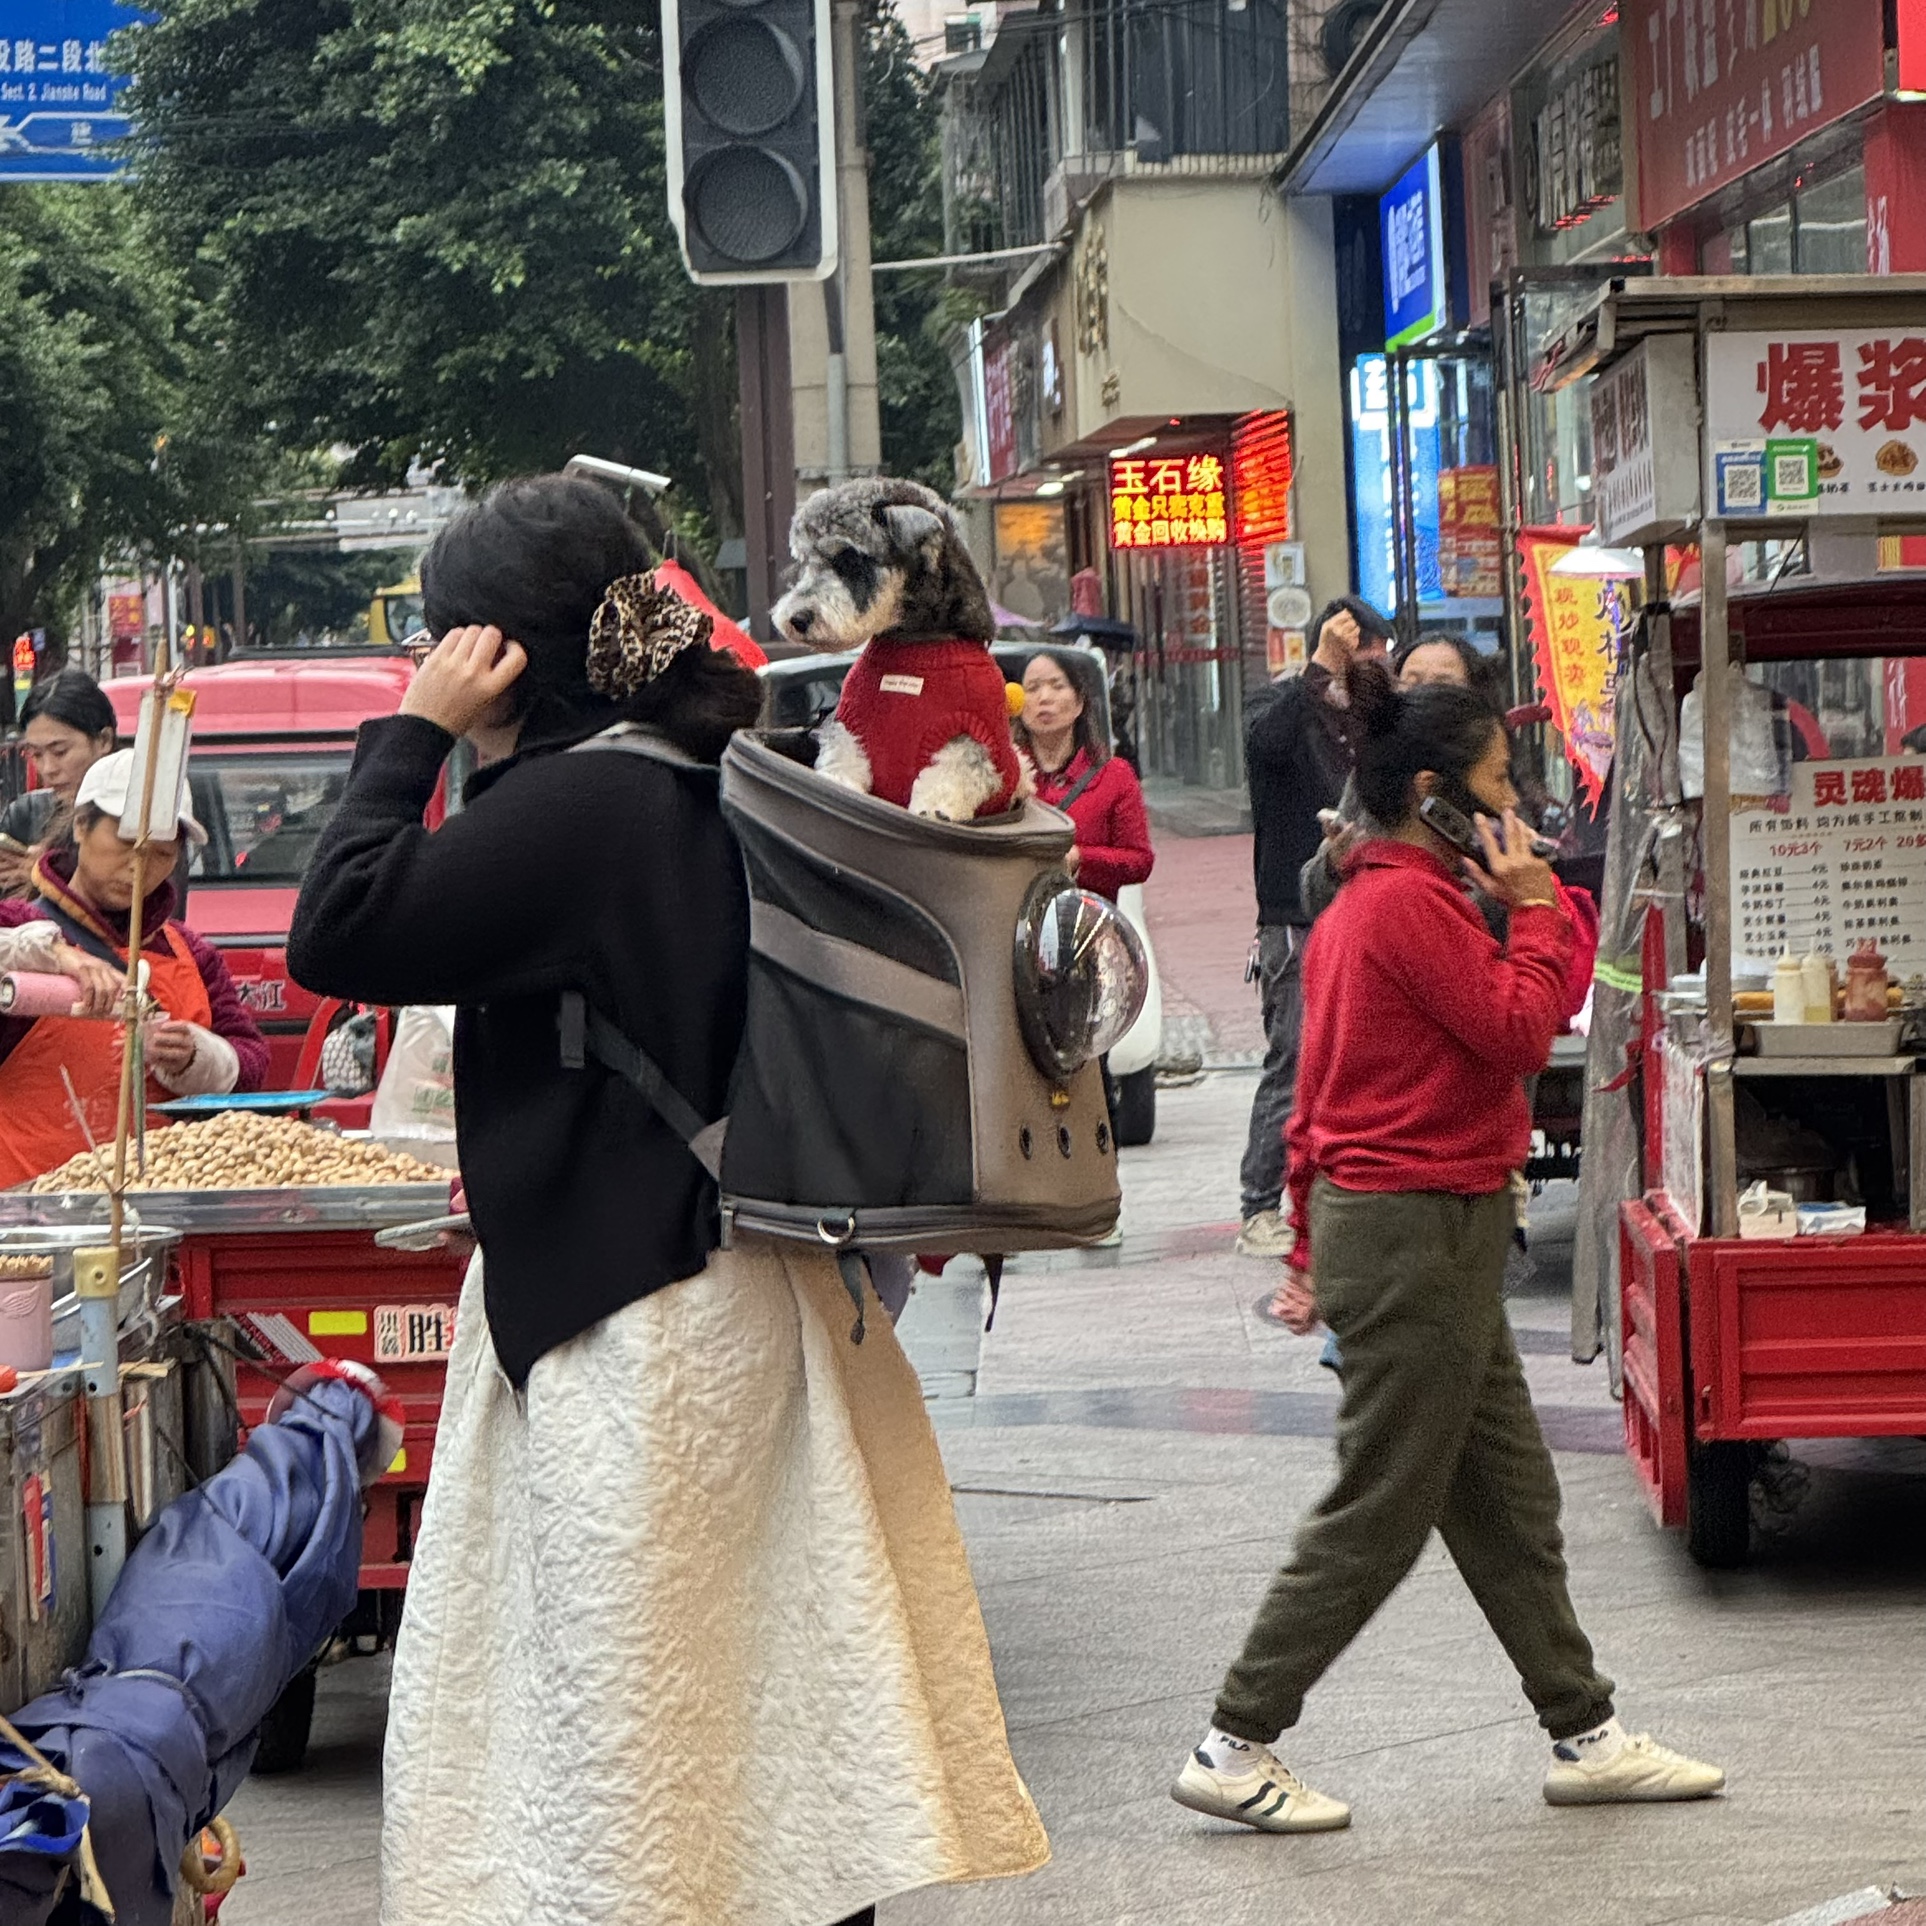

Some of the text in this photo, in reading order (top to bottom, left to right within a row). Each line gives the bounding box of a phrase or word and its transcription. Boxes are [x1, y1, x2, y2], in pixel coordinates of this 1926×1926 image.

[82, 82, 107, 101] Road
[1756, 337, 1926, 434] 爆浆
[1112, 453, 1224, 495] 玉石缘
[1813, 765, 1926, 808] 灵魂爆
